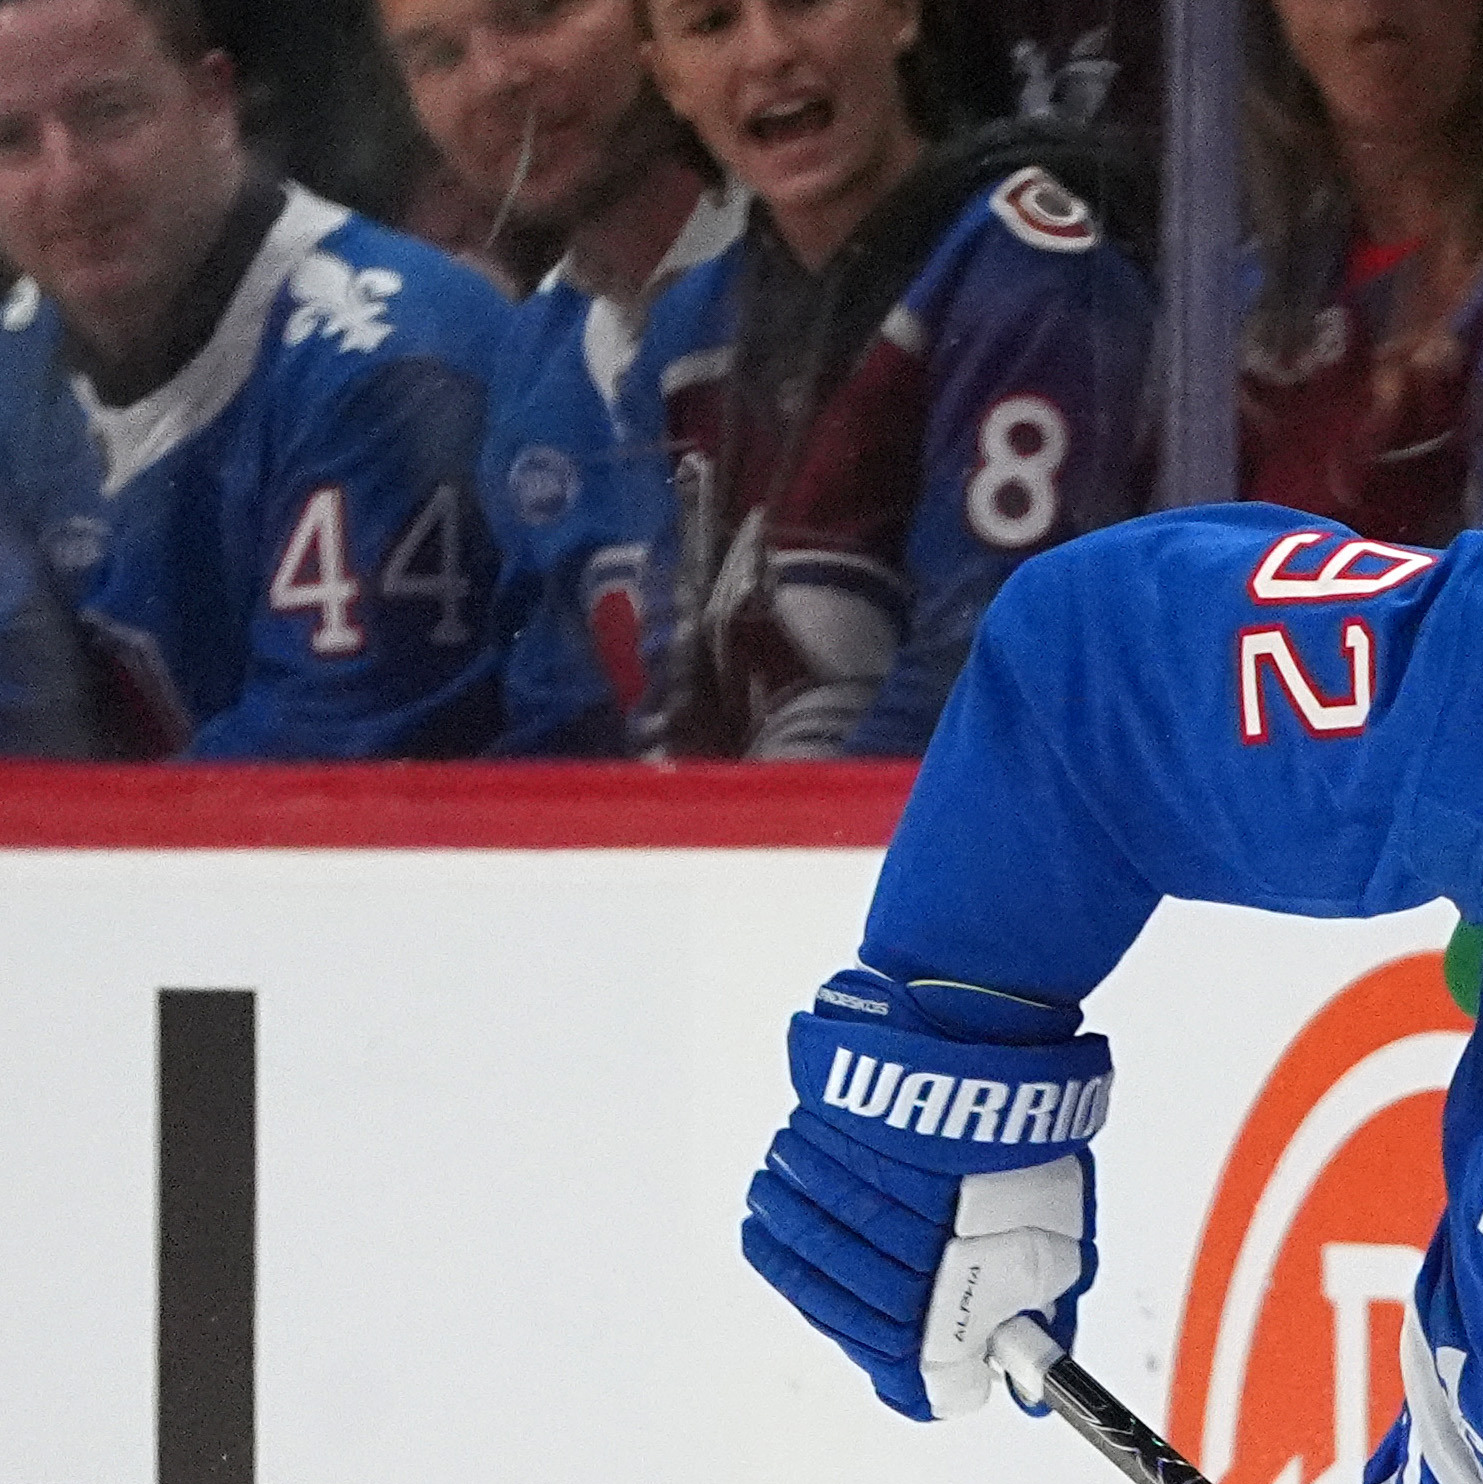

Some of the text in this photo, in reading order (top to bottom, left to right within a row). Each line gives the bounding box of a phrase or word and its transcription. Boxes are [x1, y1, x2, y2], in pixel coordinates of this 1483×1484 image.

[965, 395, 1070, 549] 8
[1237, 528, 1440, 746] 92
[823, 1045, 1115, 1144] WARRIO
